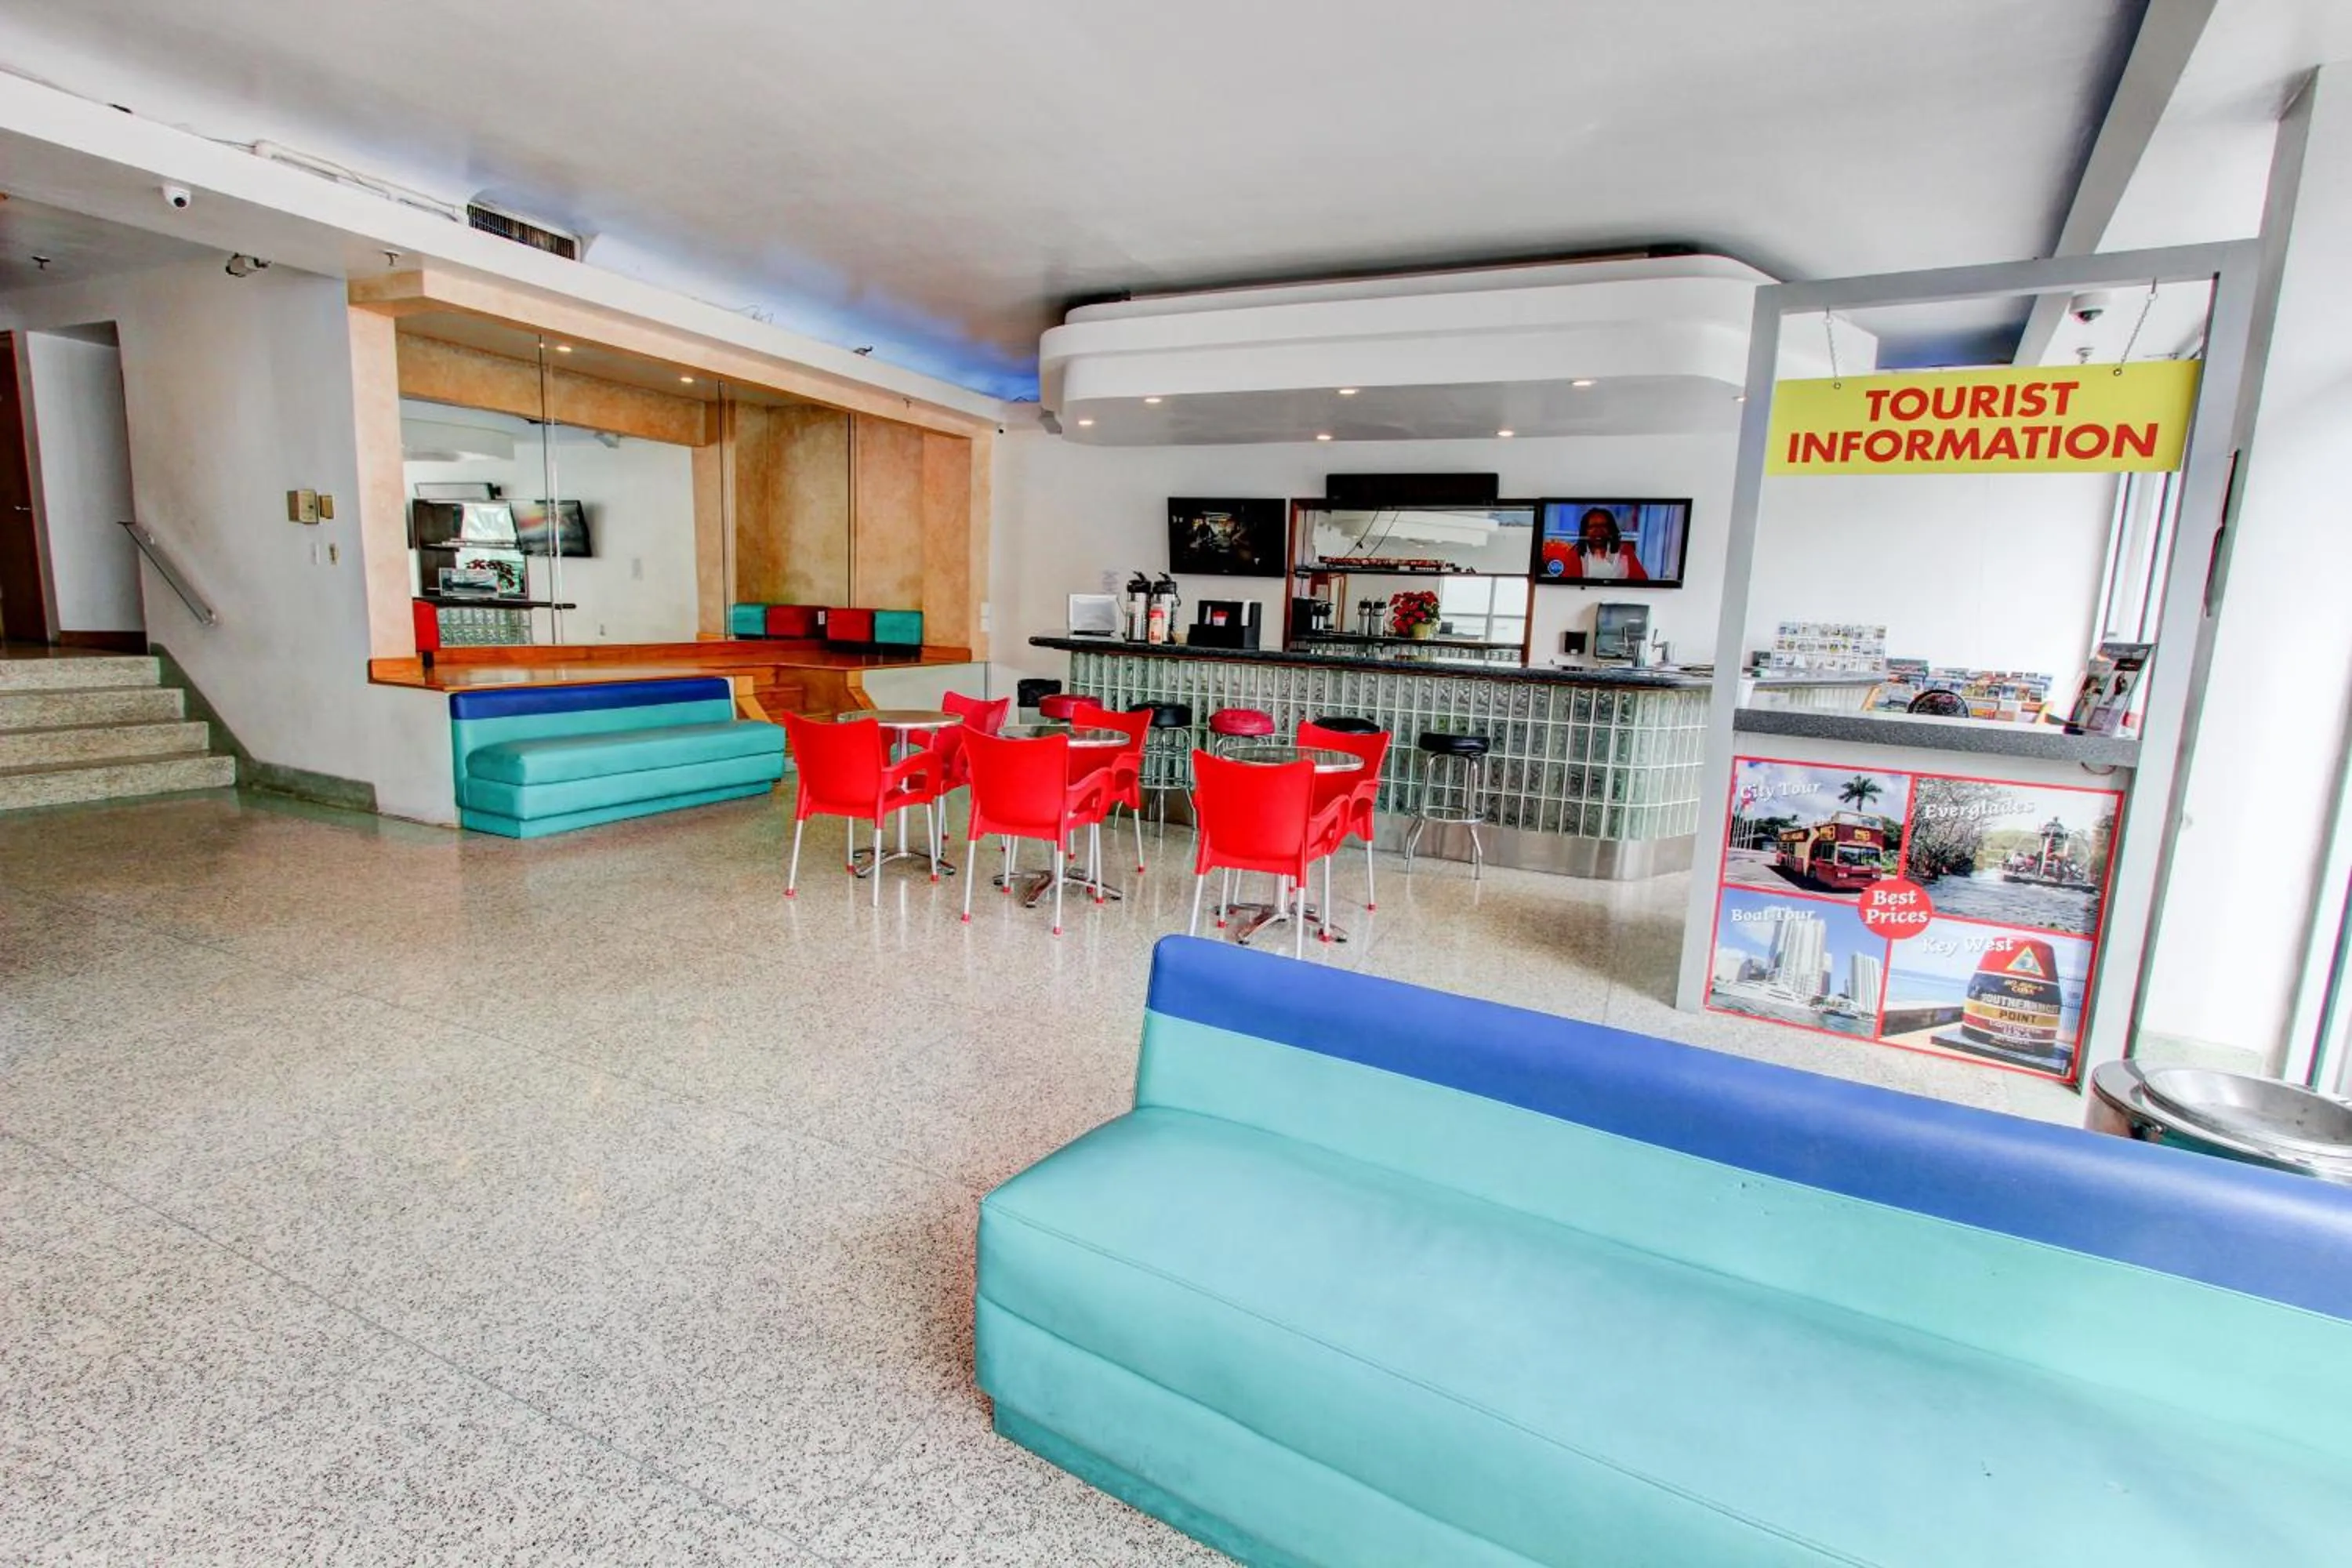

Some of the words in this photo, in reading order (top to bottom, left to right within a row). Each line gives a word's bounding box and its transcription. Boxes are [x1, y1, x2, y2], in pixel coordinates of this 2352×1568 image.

[1865, 381, 2080, 421] TOURIST
[1787, 423, 2159, 463] INFORMATION
[1740, 783, 1775, 801] City
[1778, 782, 1821, 796] Tour
[1923, 799, 2036, 821] Everglades
[1871, 890, 1917, 906] Best
[1730, 908, 1771, 923] Boat
[1773, 907, 1817, 922] Tour
[1865, 906, 1928, 925] Prices
[1922, 937, 1959, 958] Key
[1964, 937, 2014, 953] West
[1980, 993, 2060, 1014] SOUTHEOT
[1999, 1009, 2037, 1023] POINT
